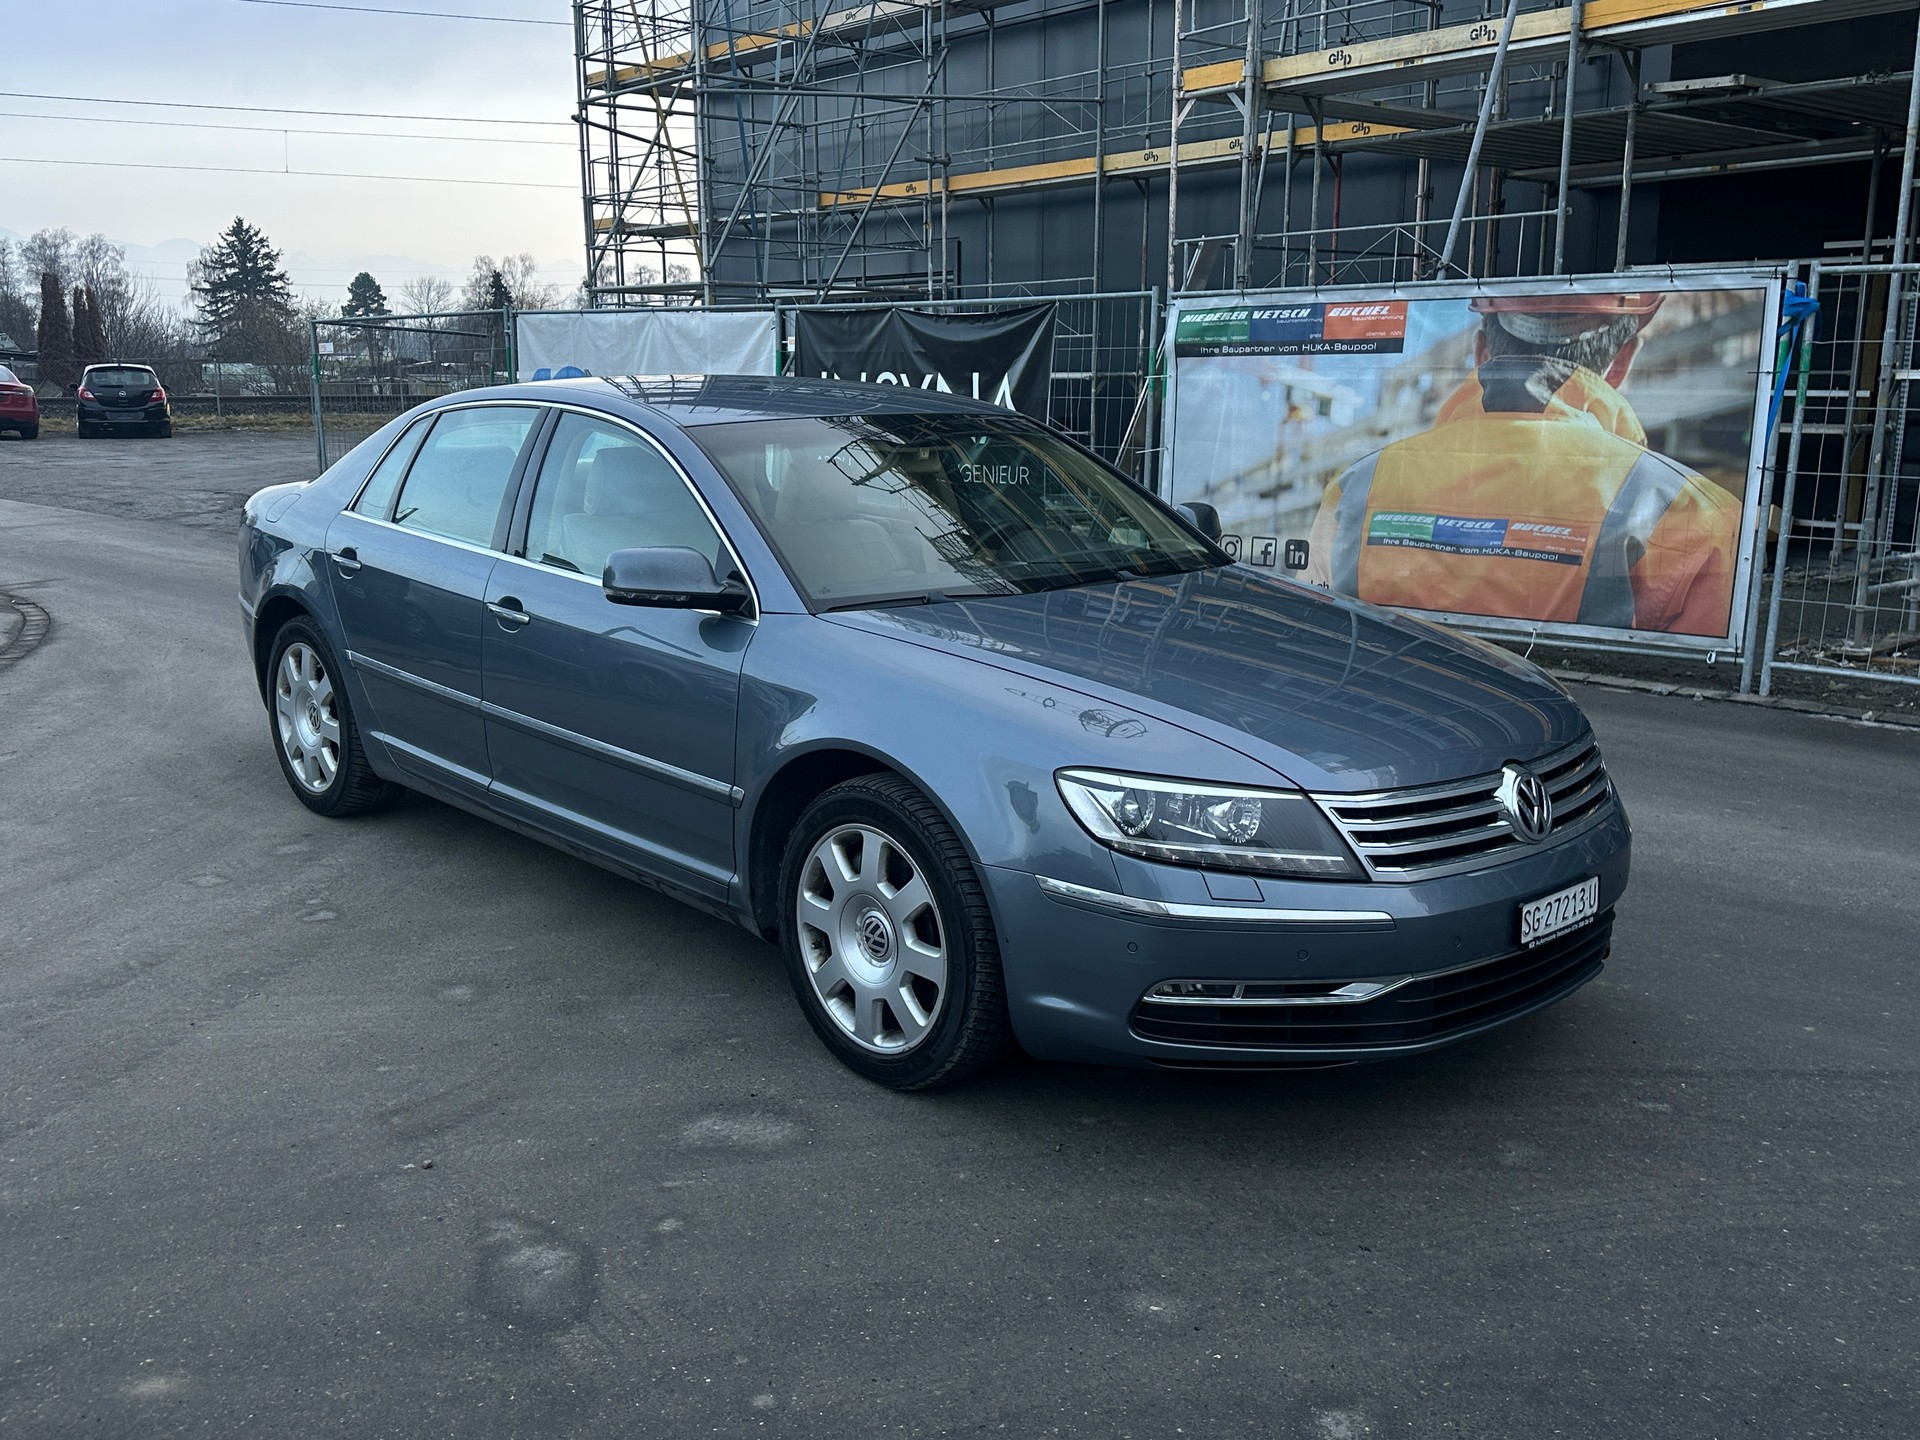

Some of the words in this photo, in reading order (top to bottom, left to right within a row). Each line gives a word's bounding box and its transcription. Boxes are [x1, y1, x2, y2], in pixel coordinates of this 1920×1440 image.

[1469, 25, 1497, 41] GBD
[1328, 50, 1352, 65] GBD
[1351, 121, 1371, 135] GBD
[1143, 151, 1159, 162] GBD
[1181, 311, 1249, 323] NIEDERER
[1252, 308, 1311, 319] VETSCH
[1200, 346, 1220, 354] Ihre
[1222, 345, 1275, 354] Baupartner
[1278, 345, 1298, 353] vom
[1302, 342, 1377, 352] HUKA-Baupool
[1437, 518, 1495, 529] VETSCH
[1402, 539, 1457, 552] Baupartner
